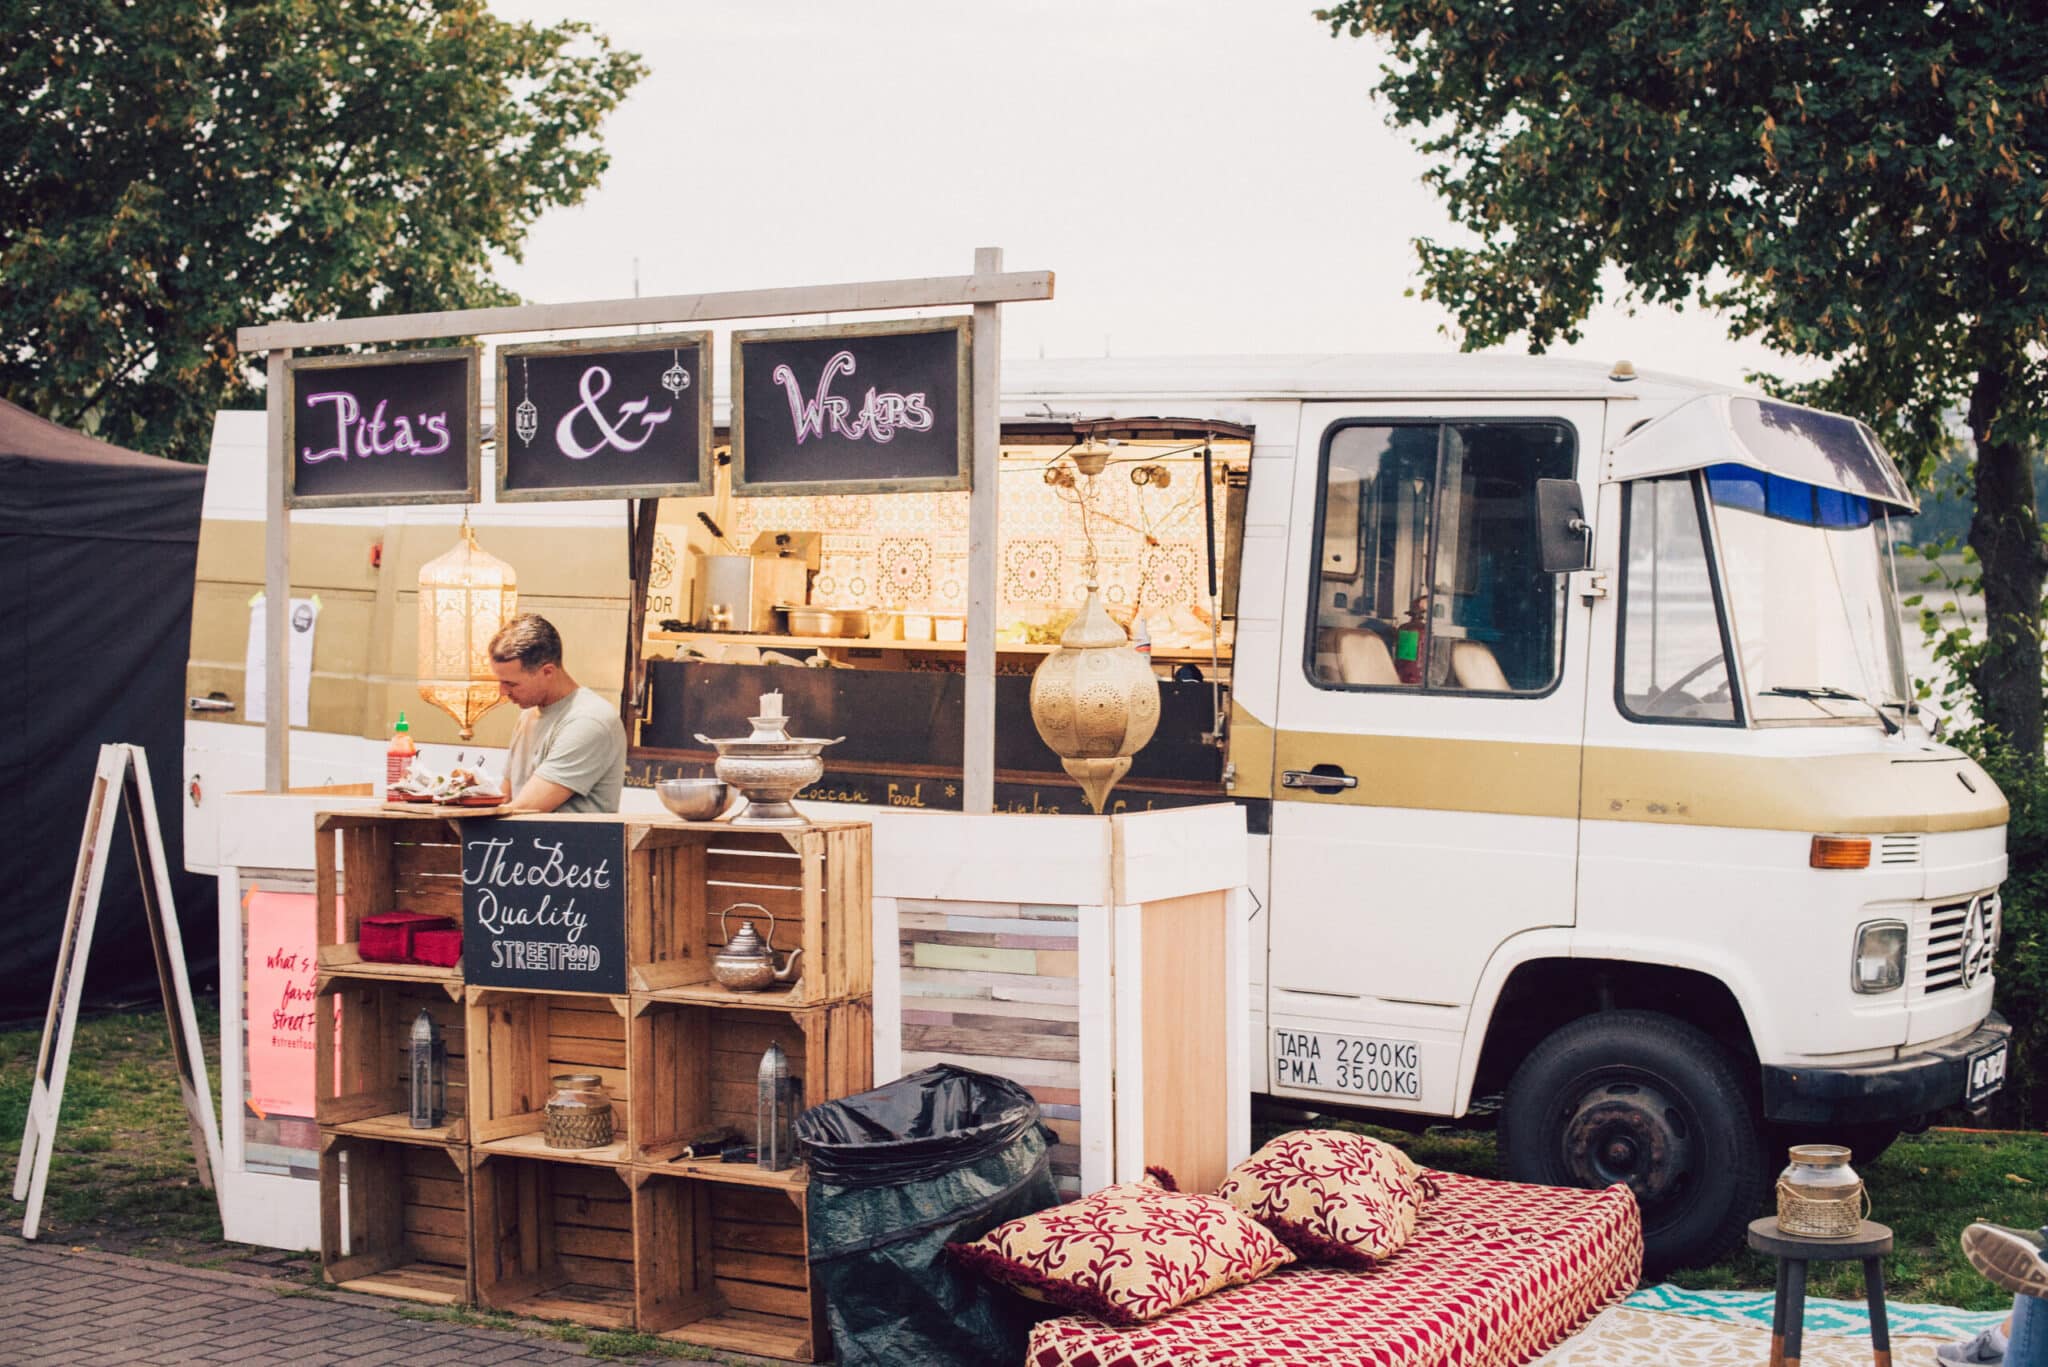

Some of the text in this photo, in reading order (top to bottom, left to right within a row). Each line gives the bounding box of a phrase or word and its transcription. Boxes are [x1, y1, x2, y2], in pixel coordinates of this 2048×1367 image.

[303, 391, 450, 464] Pita's
[555, 366, 673, 459] &
[797, 783, 925, 808] occan Food
[463, 837, 611, 889] The Best
[477, 888, 589, 943] Quality
[491, 940, 601, 972] STREETFOOD
[1277, 1032, 1321, 1060] TARA
